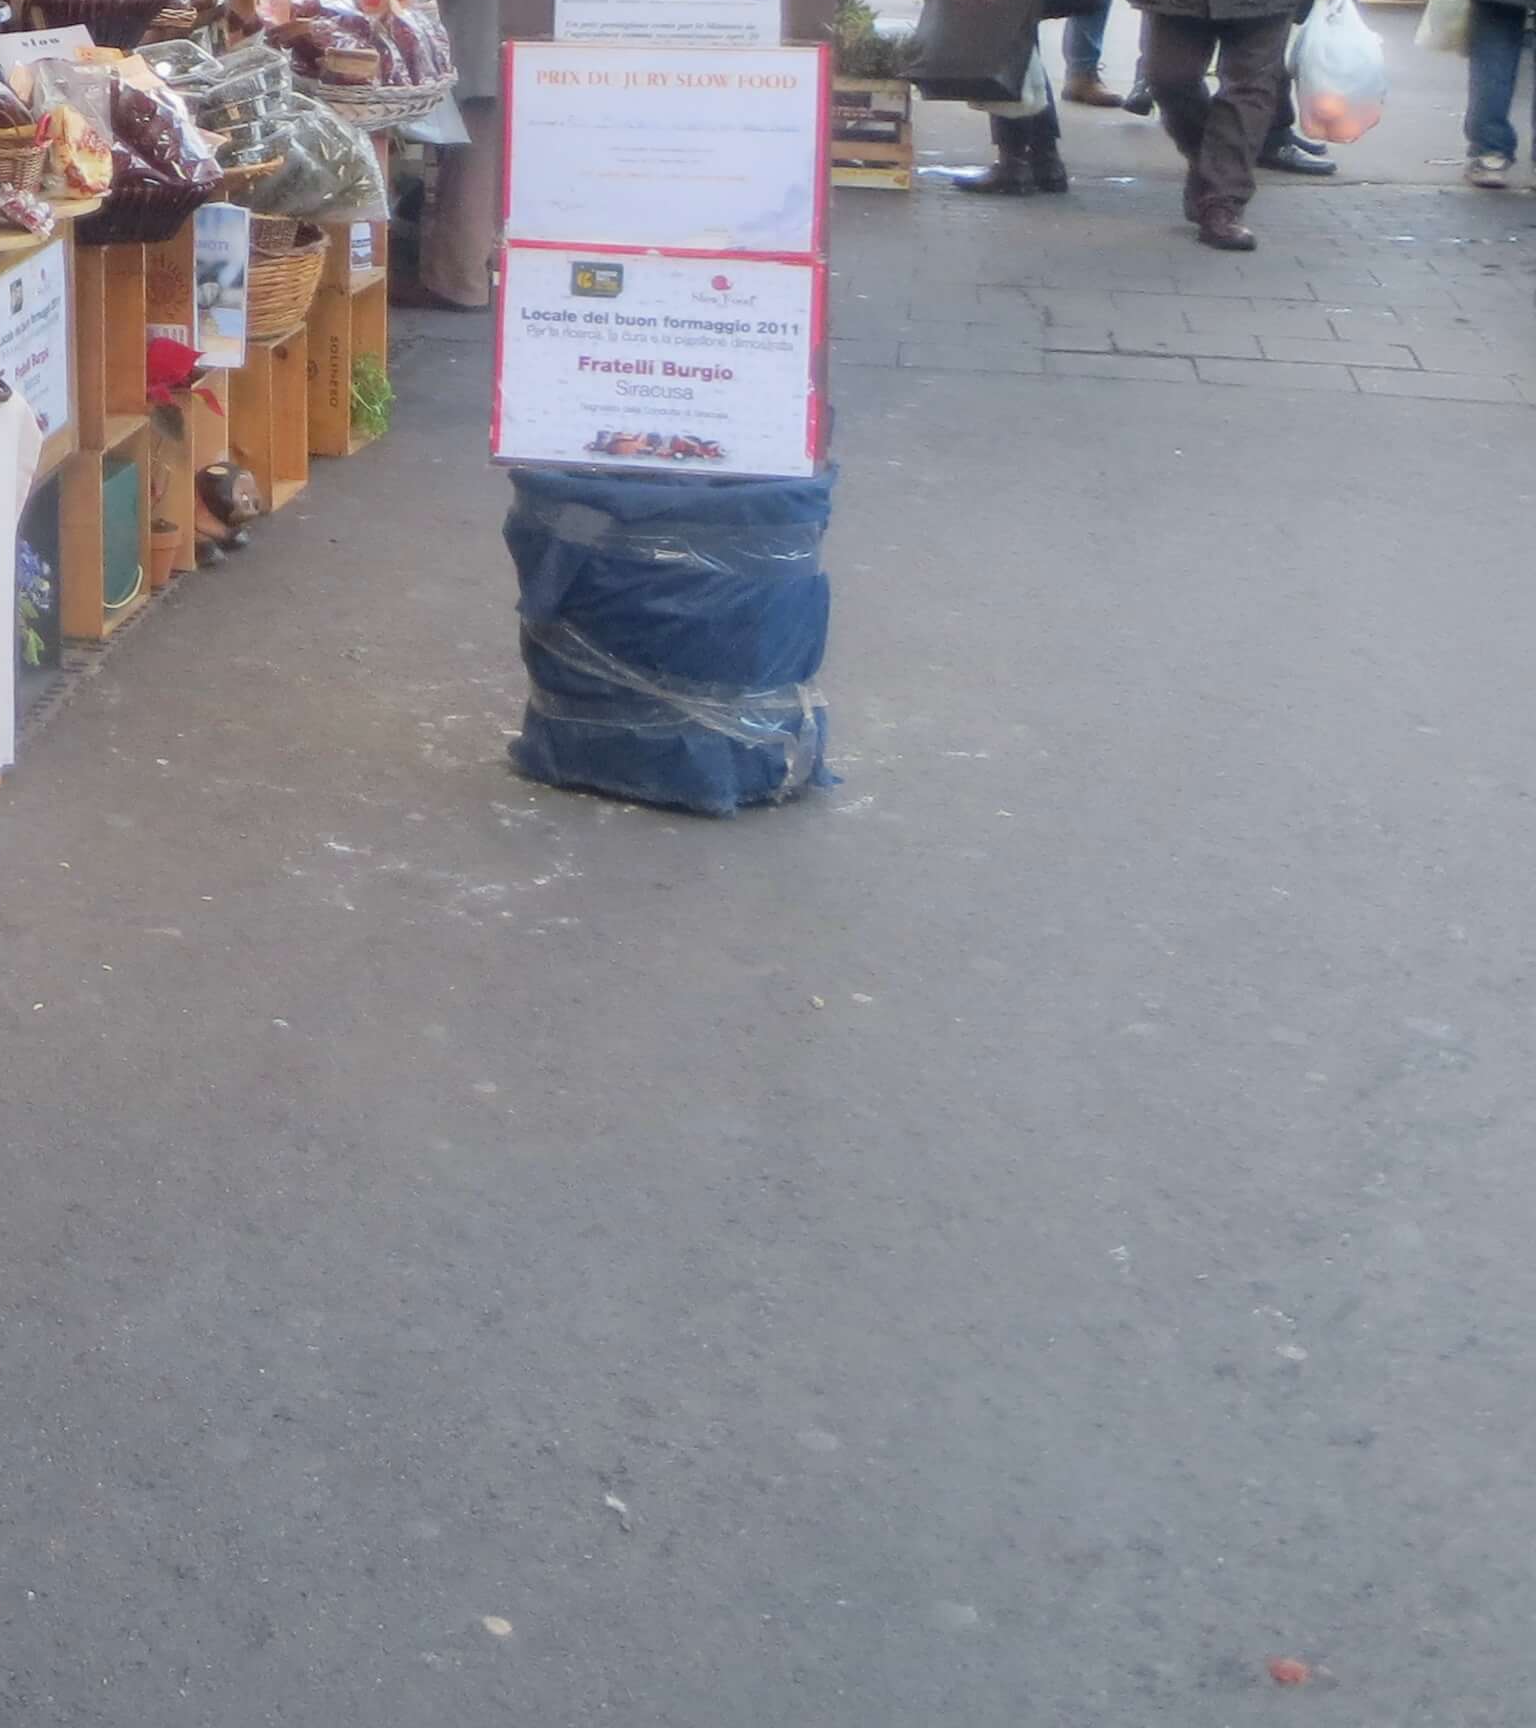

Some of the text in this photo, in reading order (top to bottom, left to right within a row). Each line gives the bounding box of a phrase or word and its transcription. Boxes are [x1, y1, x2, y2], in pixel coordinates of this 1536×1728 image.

[536, 71, 796, 89] PRIX DU JURY SLOW FOOD
[521, 307, 800, 335] Locale del buon formaggio 2011
[578, 355, 734, 382] Fratelli Burgio
[616, 379, 695, 400] Siracusa
